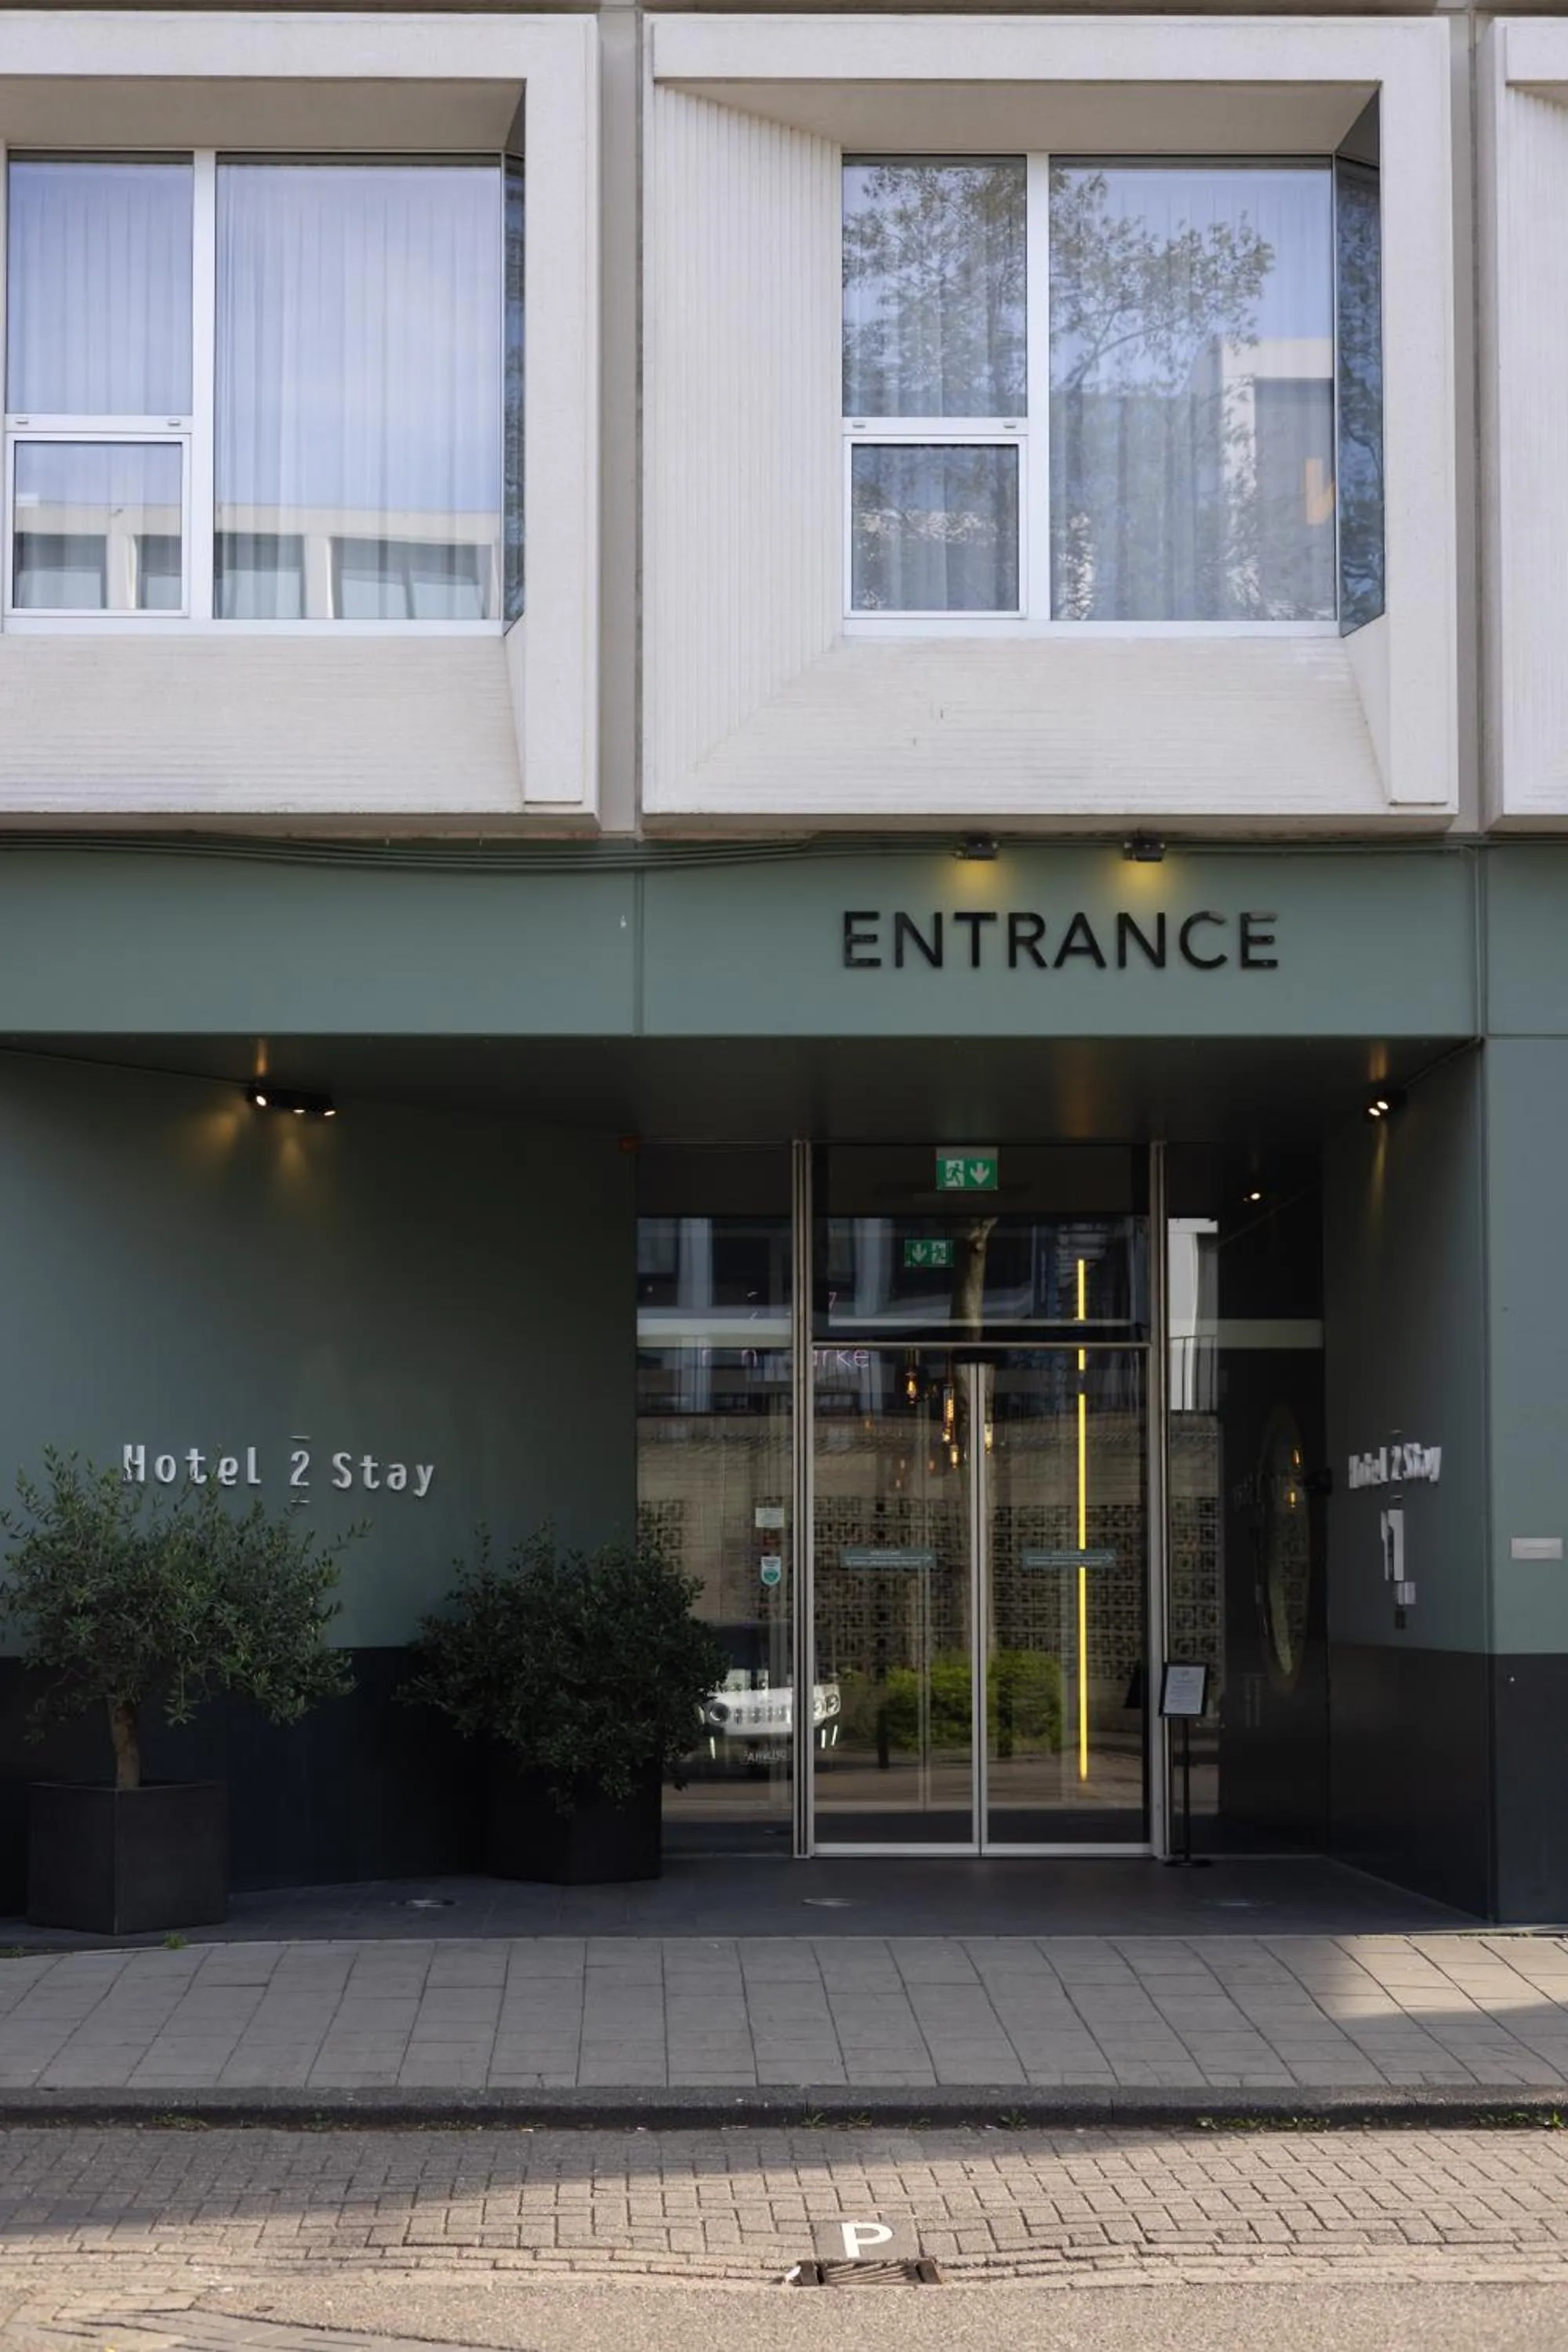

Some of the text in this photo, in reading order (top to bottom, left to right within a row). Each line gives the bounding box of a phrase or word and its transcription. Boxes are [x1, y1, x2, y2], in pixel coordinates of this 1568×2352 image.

[843, 910, 1279, 970] ENTRANCE
[123, 1444, 434, 1497] Hotel 2 Stay
[840, 2221, 893, 2259] P
